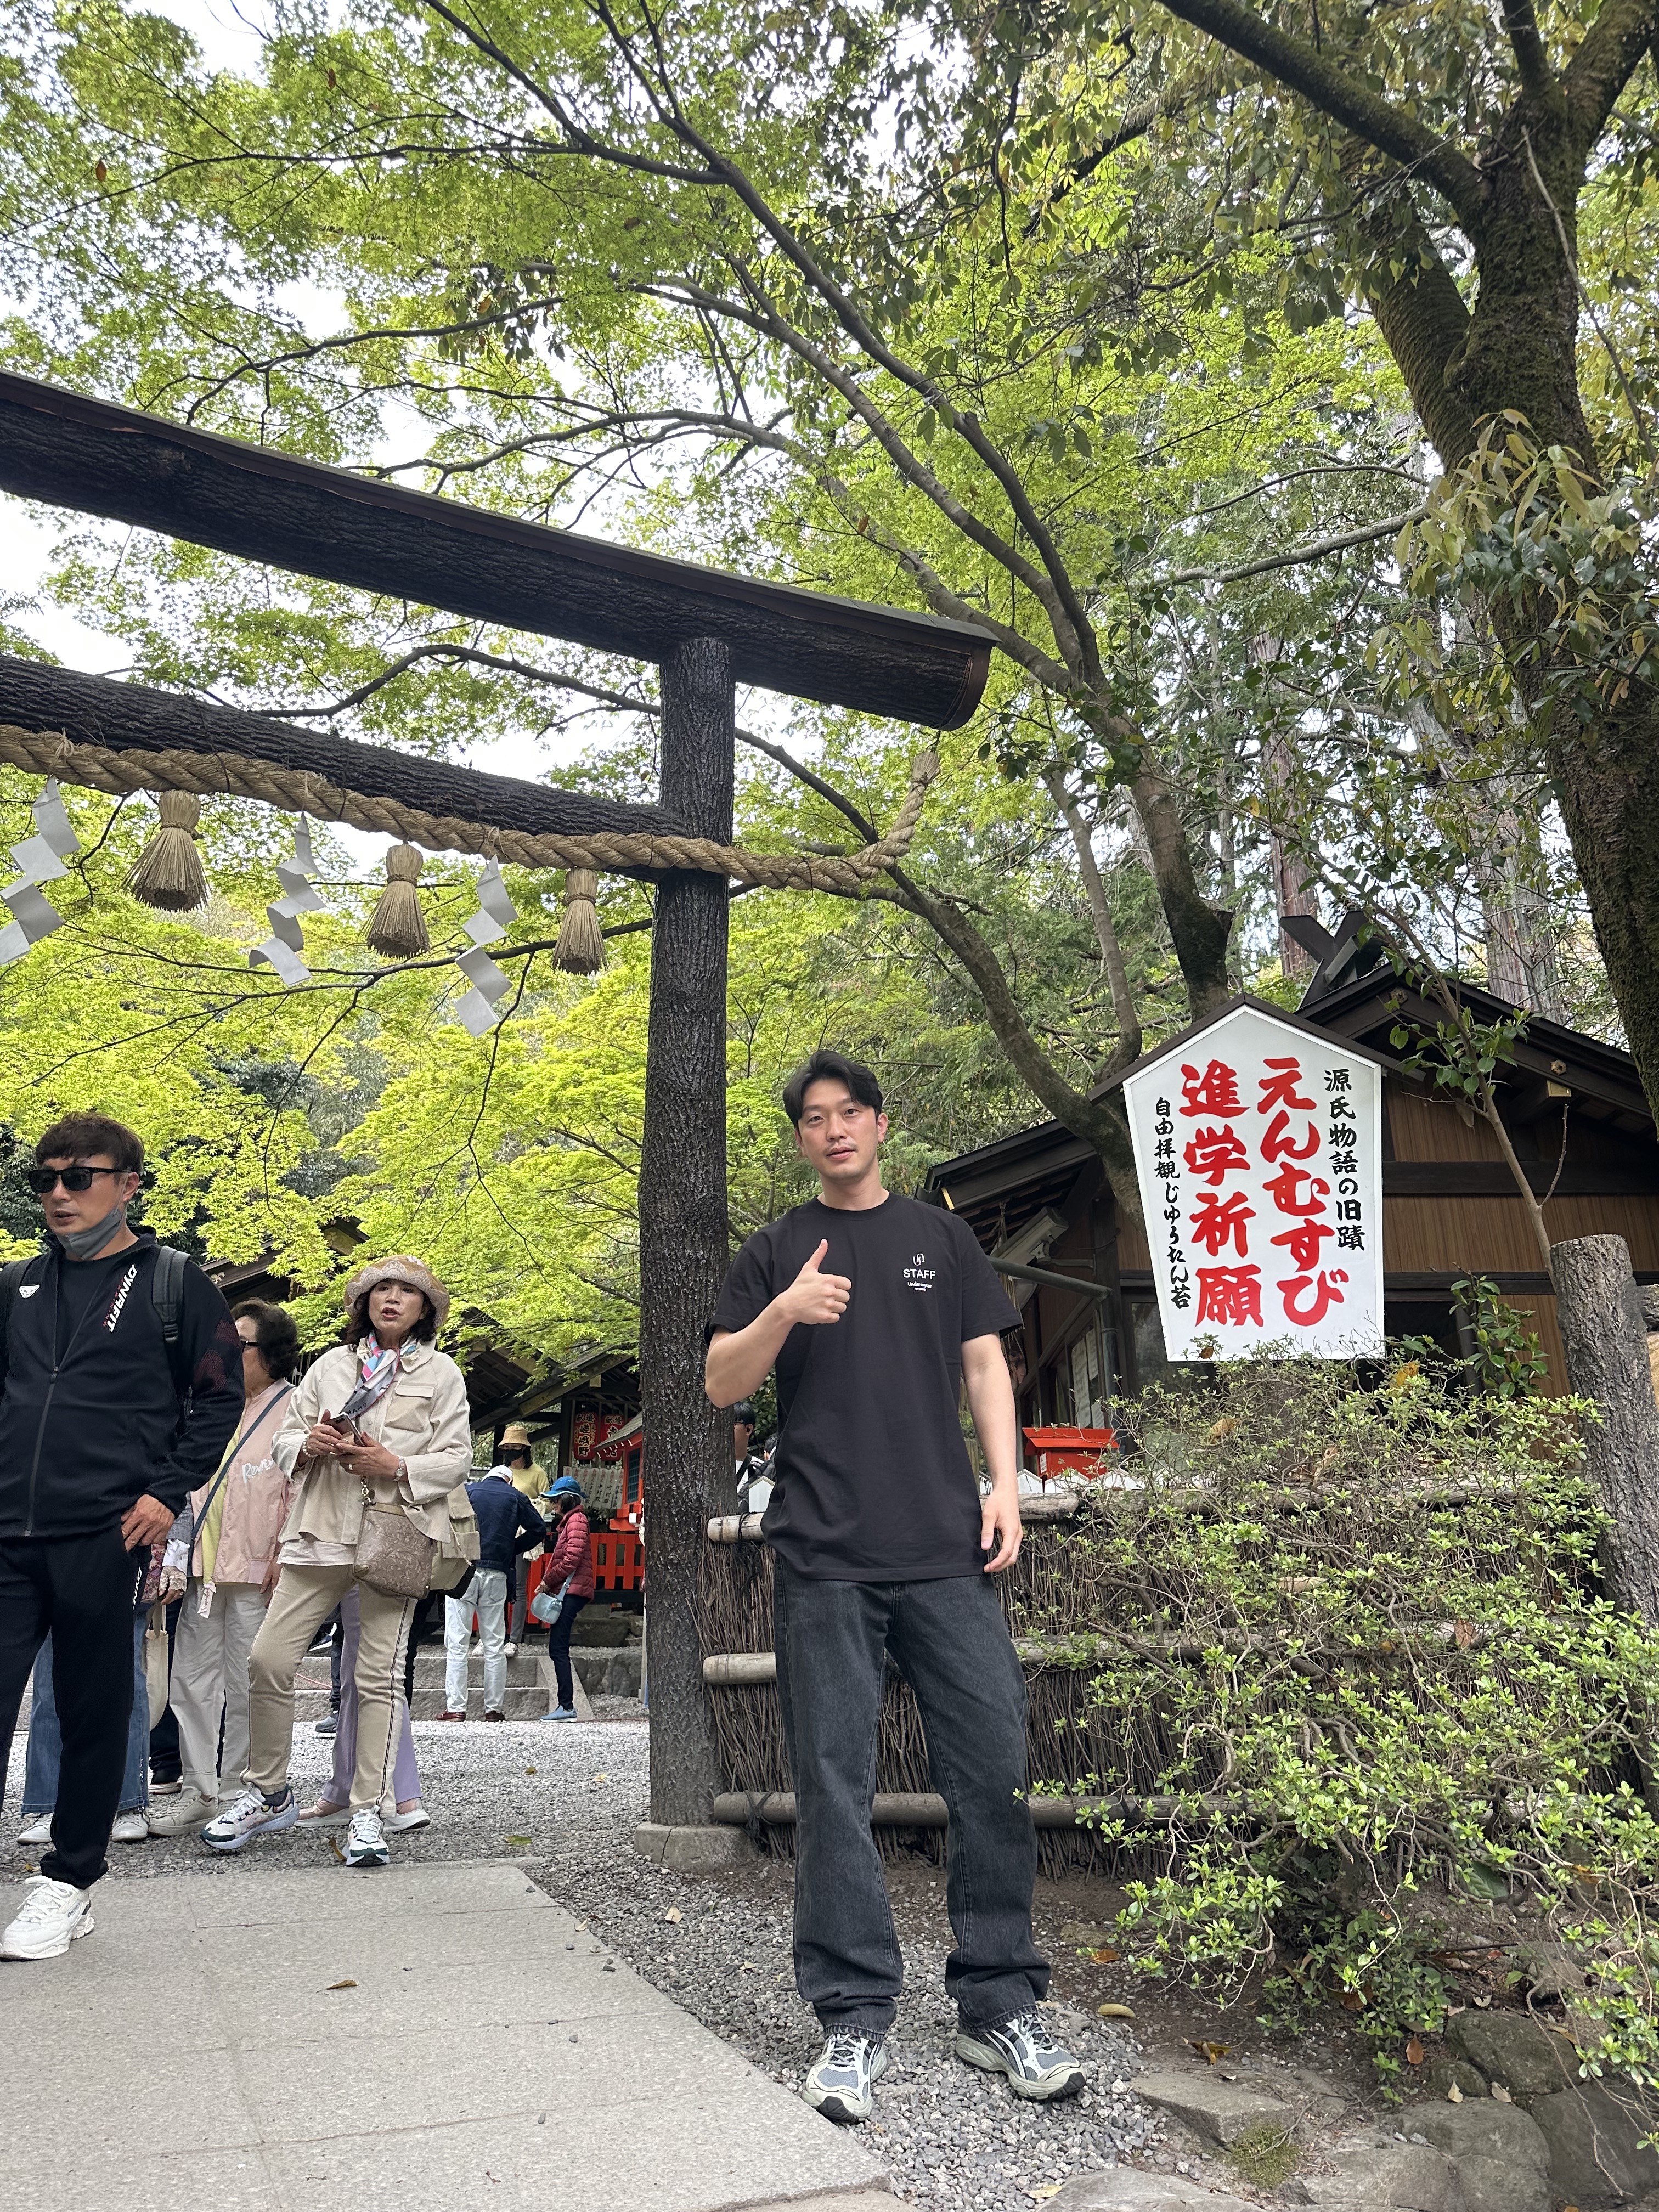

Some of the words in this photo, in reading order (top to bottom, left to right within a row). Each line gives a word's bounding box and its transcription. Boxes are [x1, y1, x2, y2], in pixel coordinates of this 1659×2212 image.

[1179, 1059, 1264, 1327] 進学祈願
[1257, 1057, 1350, 1327] えんむすび
[1324, 1068, 1365, 1251] 源氏物語の旧蹟
[106, 1263, 138, 1333] DYNAFIT
[903, 1268, 936, 1279] STAFF
